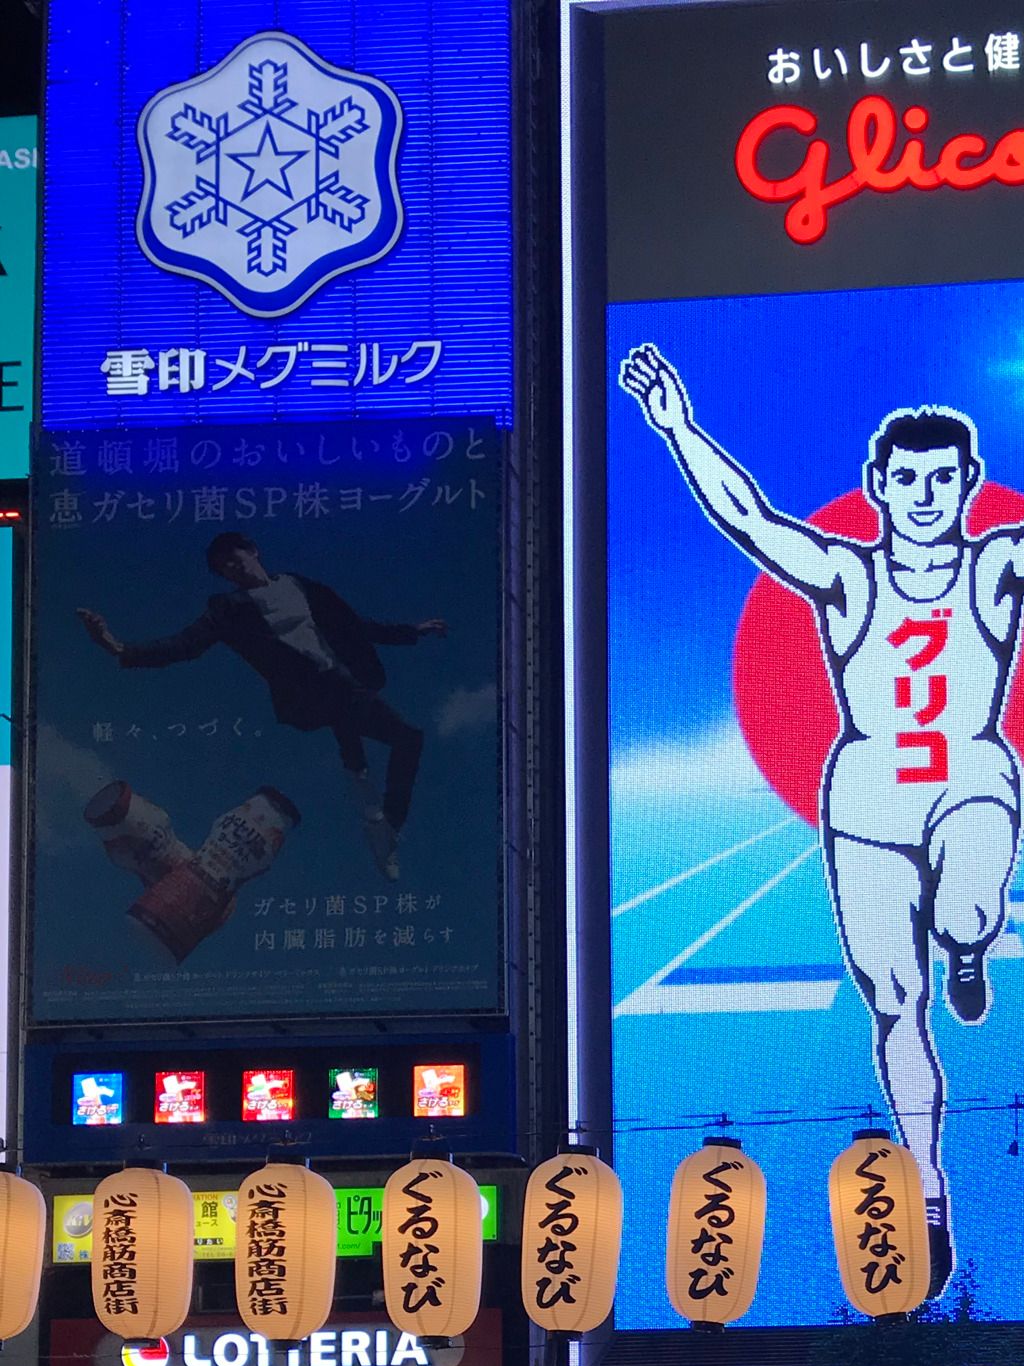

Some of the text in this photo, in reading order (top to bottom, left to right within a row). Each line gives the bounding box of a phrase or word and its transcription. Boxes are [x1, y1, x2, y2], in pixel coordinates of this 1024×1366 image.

[100, 340, 442, 395] 雪印メグミルク
[49, 427, 488, 477] 道頓堀のおいしいものと
[886, 608, 953, 784] グリコ
[253, 893, 443, 918] ガセリ菌SP株が
[253, 925, 455, 952] 内臓脂肪を減らす
[101, 1192, 140, 1316] 心斎橋筋商店街
[202, 1201, 218, 1218] 館
[246, 1182, 288, 1316] 心斎橋筋商店街
[399, 1170, 445, 1314] ぐるなび
[535, 1165, 588, 1309] ぐるなび
[687, 1160, 744, 1301] ぐるなび
[853, 1147, 905, 1295] ぐるなび
